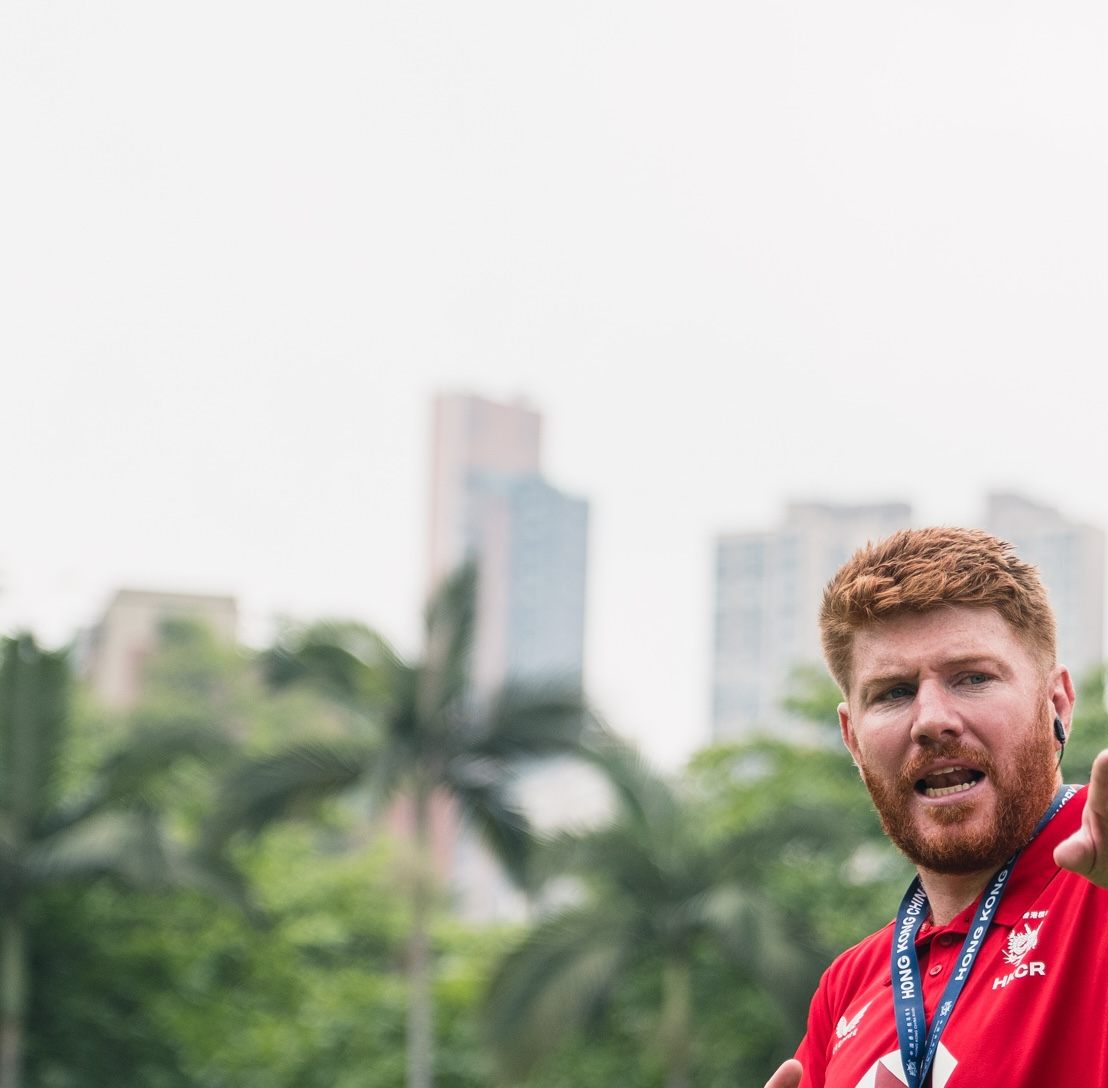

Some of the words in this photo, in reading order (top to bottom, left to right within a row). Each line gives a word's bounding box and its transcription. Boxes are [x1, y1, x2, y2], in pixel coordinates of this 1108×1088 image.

[907, 888, 927, 916] CHIN
[896, 916, 916, 953] KONG
[955, 926, 984, 981] HONG
[980, 869, 1008, 921] KONG
[897, 955, 915, 1000] HONG
